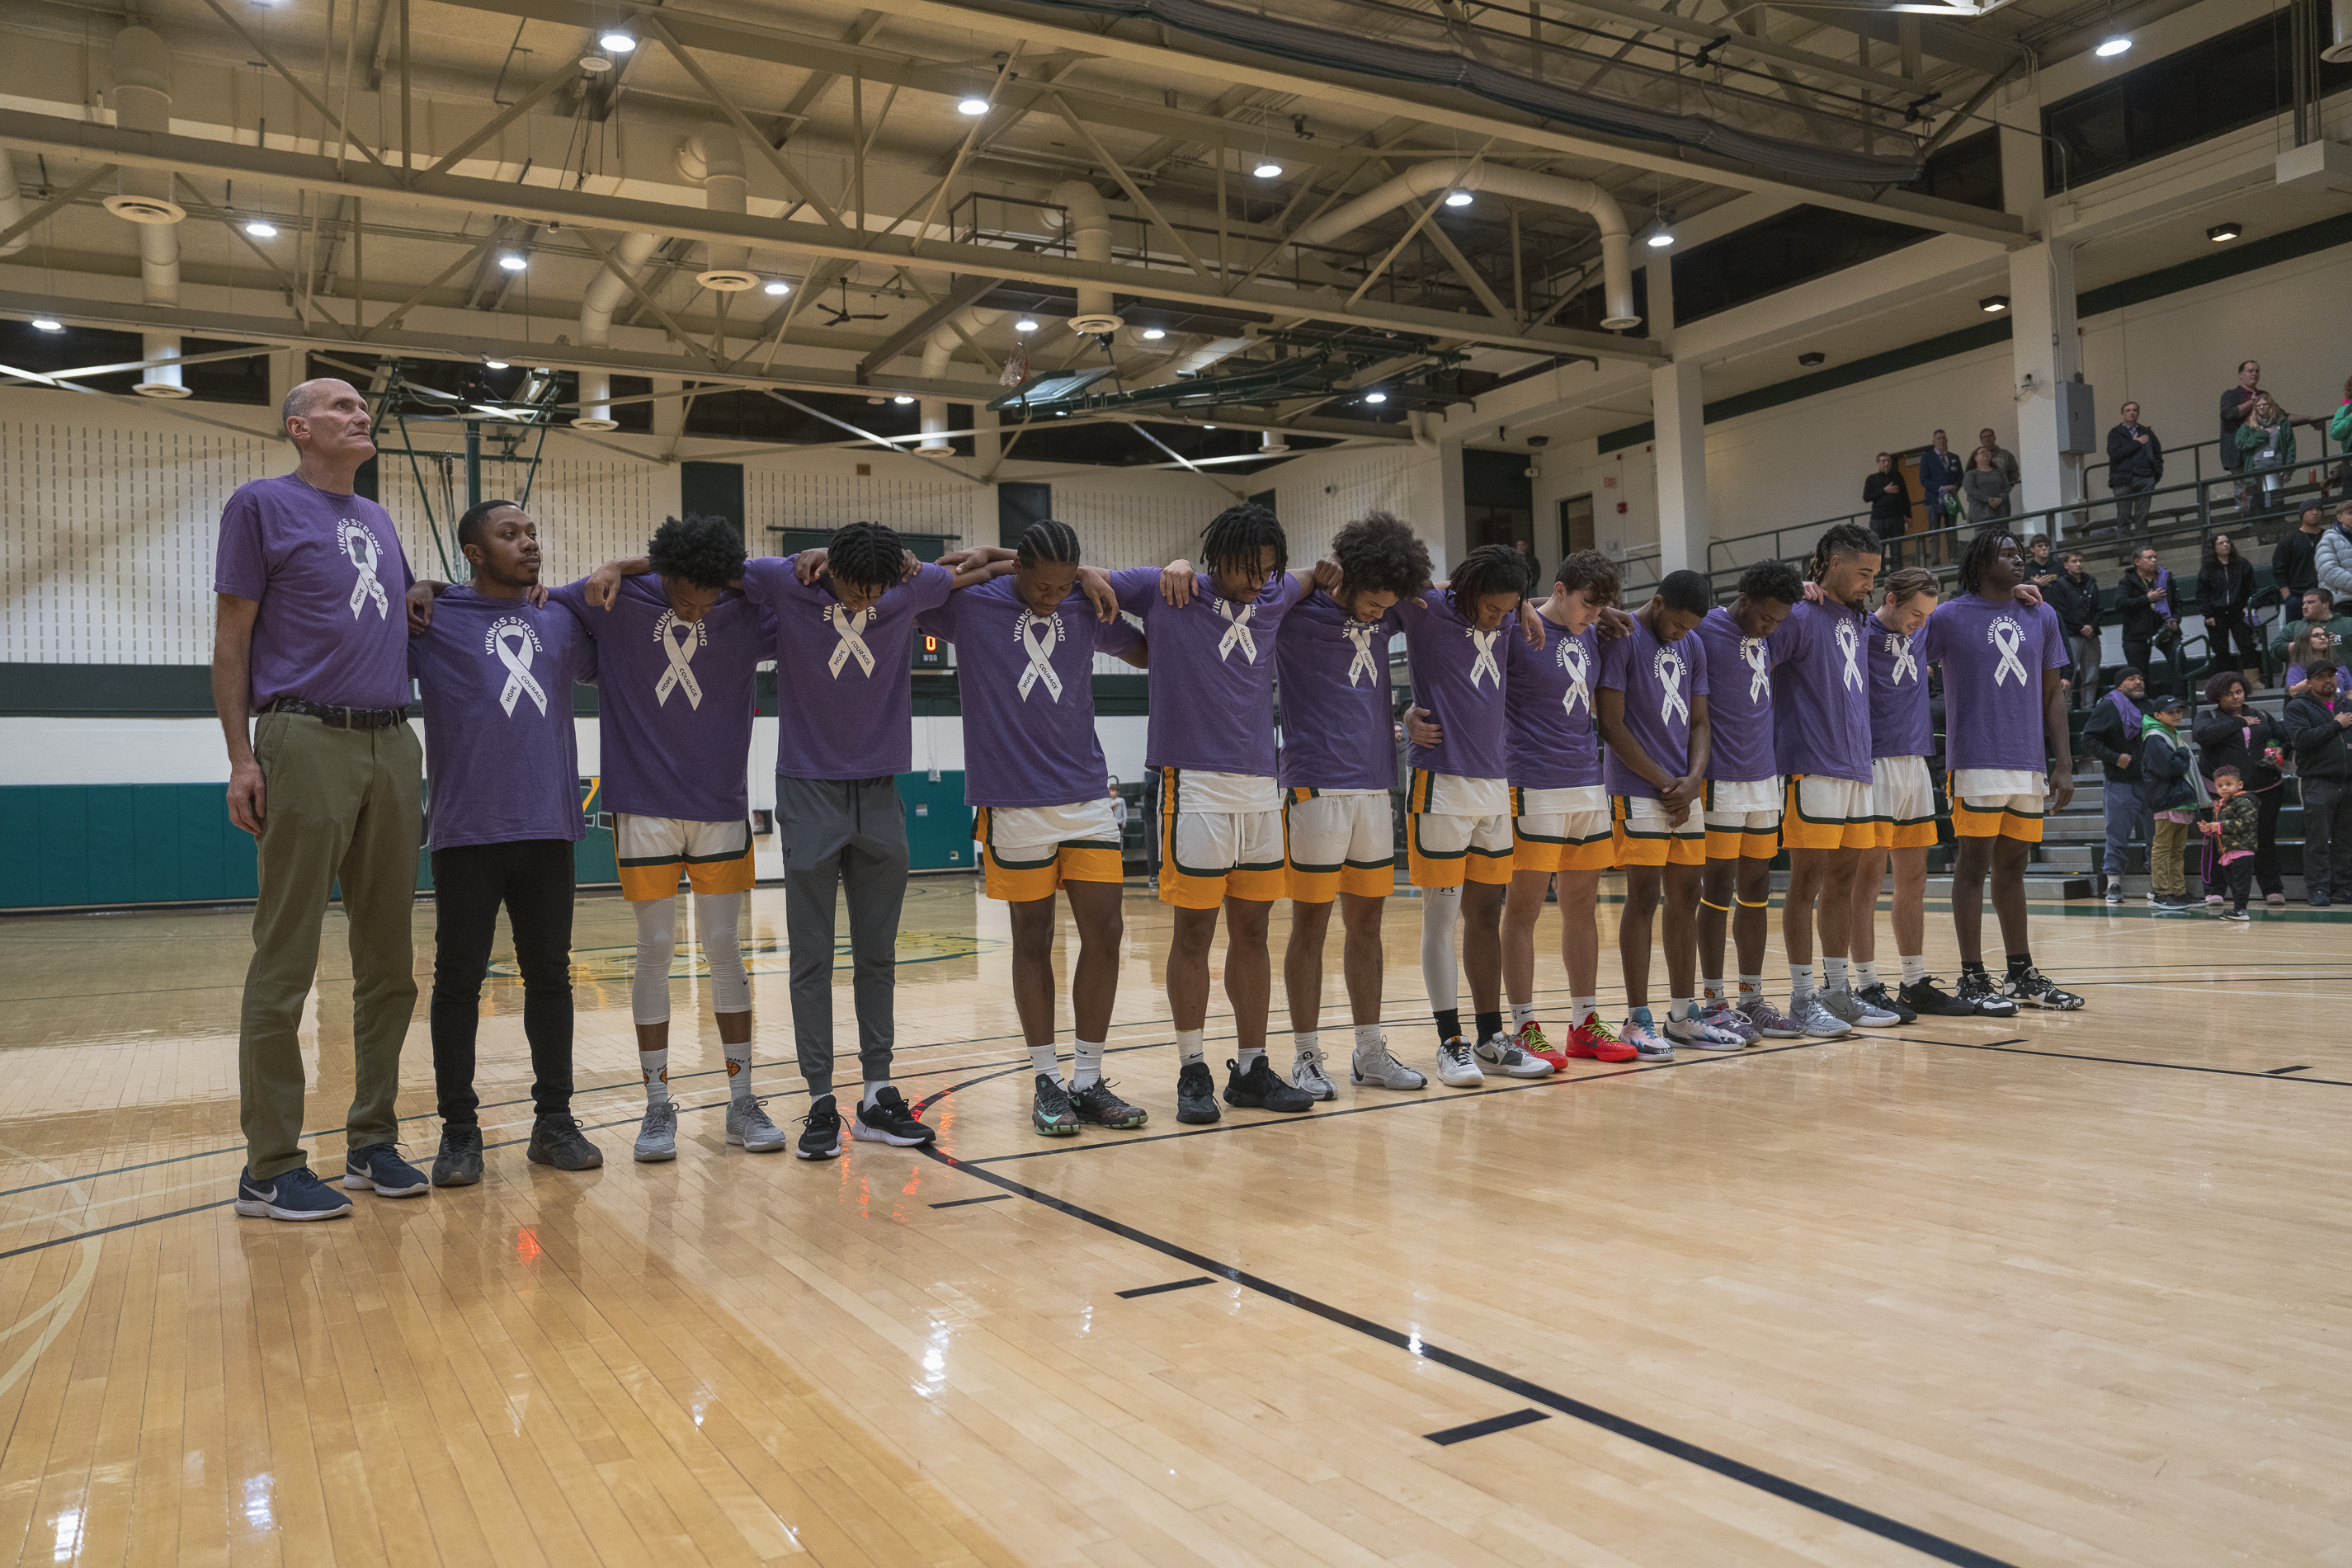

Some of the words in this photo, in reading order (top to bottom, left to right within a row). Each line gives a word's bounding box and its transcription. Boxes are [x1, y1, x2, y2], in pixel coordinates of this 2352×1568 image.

[337, 518, 350, 555] VIKINGS
[350, 518, 384, 555] STRONG
[353, 587, 365, 605] HOPE
[368, 577, 386, 606] COURAGE
[485, 617, 507, 655] VIKINGS
[510, 616, 543, 652] STRONG
[653, 608, 676, 642] VIKING
[1013, 608, 1033, 642] VIKING
[1050, 611, 1066, 642] RONG
[1987, 616, 2002, 644] VIKINGS
[2004, 615, 2026, 642] STRONG
[851, 640, 871, 666] COURAGE
[1240, 628, 1254, 654] COURAGE
[1555, 637, 1569, 667] VIKINGS
[1570, 637, 1591, 666] STRONG
[833, 649, 846, 666] HOPE
[1351, 662, 1360, 676] HOPE
[1653, 647, 1666, 678] VIKINGS
[1666, 647, 1687, 676] STRONG
[1895, 663, 1903, 676] HOPE
[2010, 657, 2024, 677] COURAGE
[660, 676, 673, 692] HOPE
[679, 667, 698, 697] COURAGE
[1022, 671, 1035, 688] HOPE
[1039, 663, 1058, 690] COURAGE
[1997, 665, 2006, 677] HOPE
[505, 685, 517, 702] HOPE
[521, 676, 544, 703] COURAGE
[1566, 690, 1575, 704] HOPE
[1671, 694, 1687, 715] COURAGE
